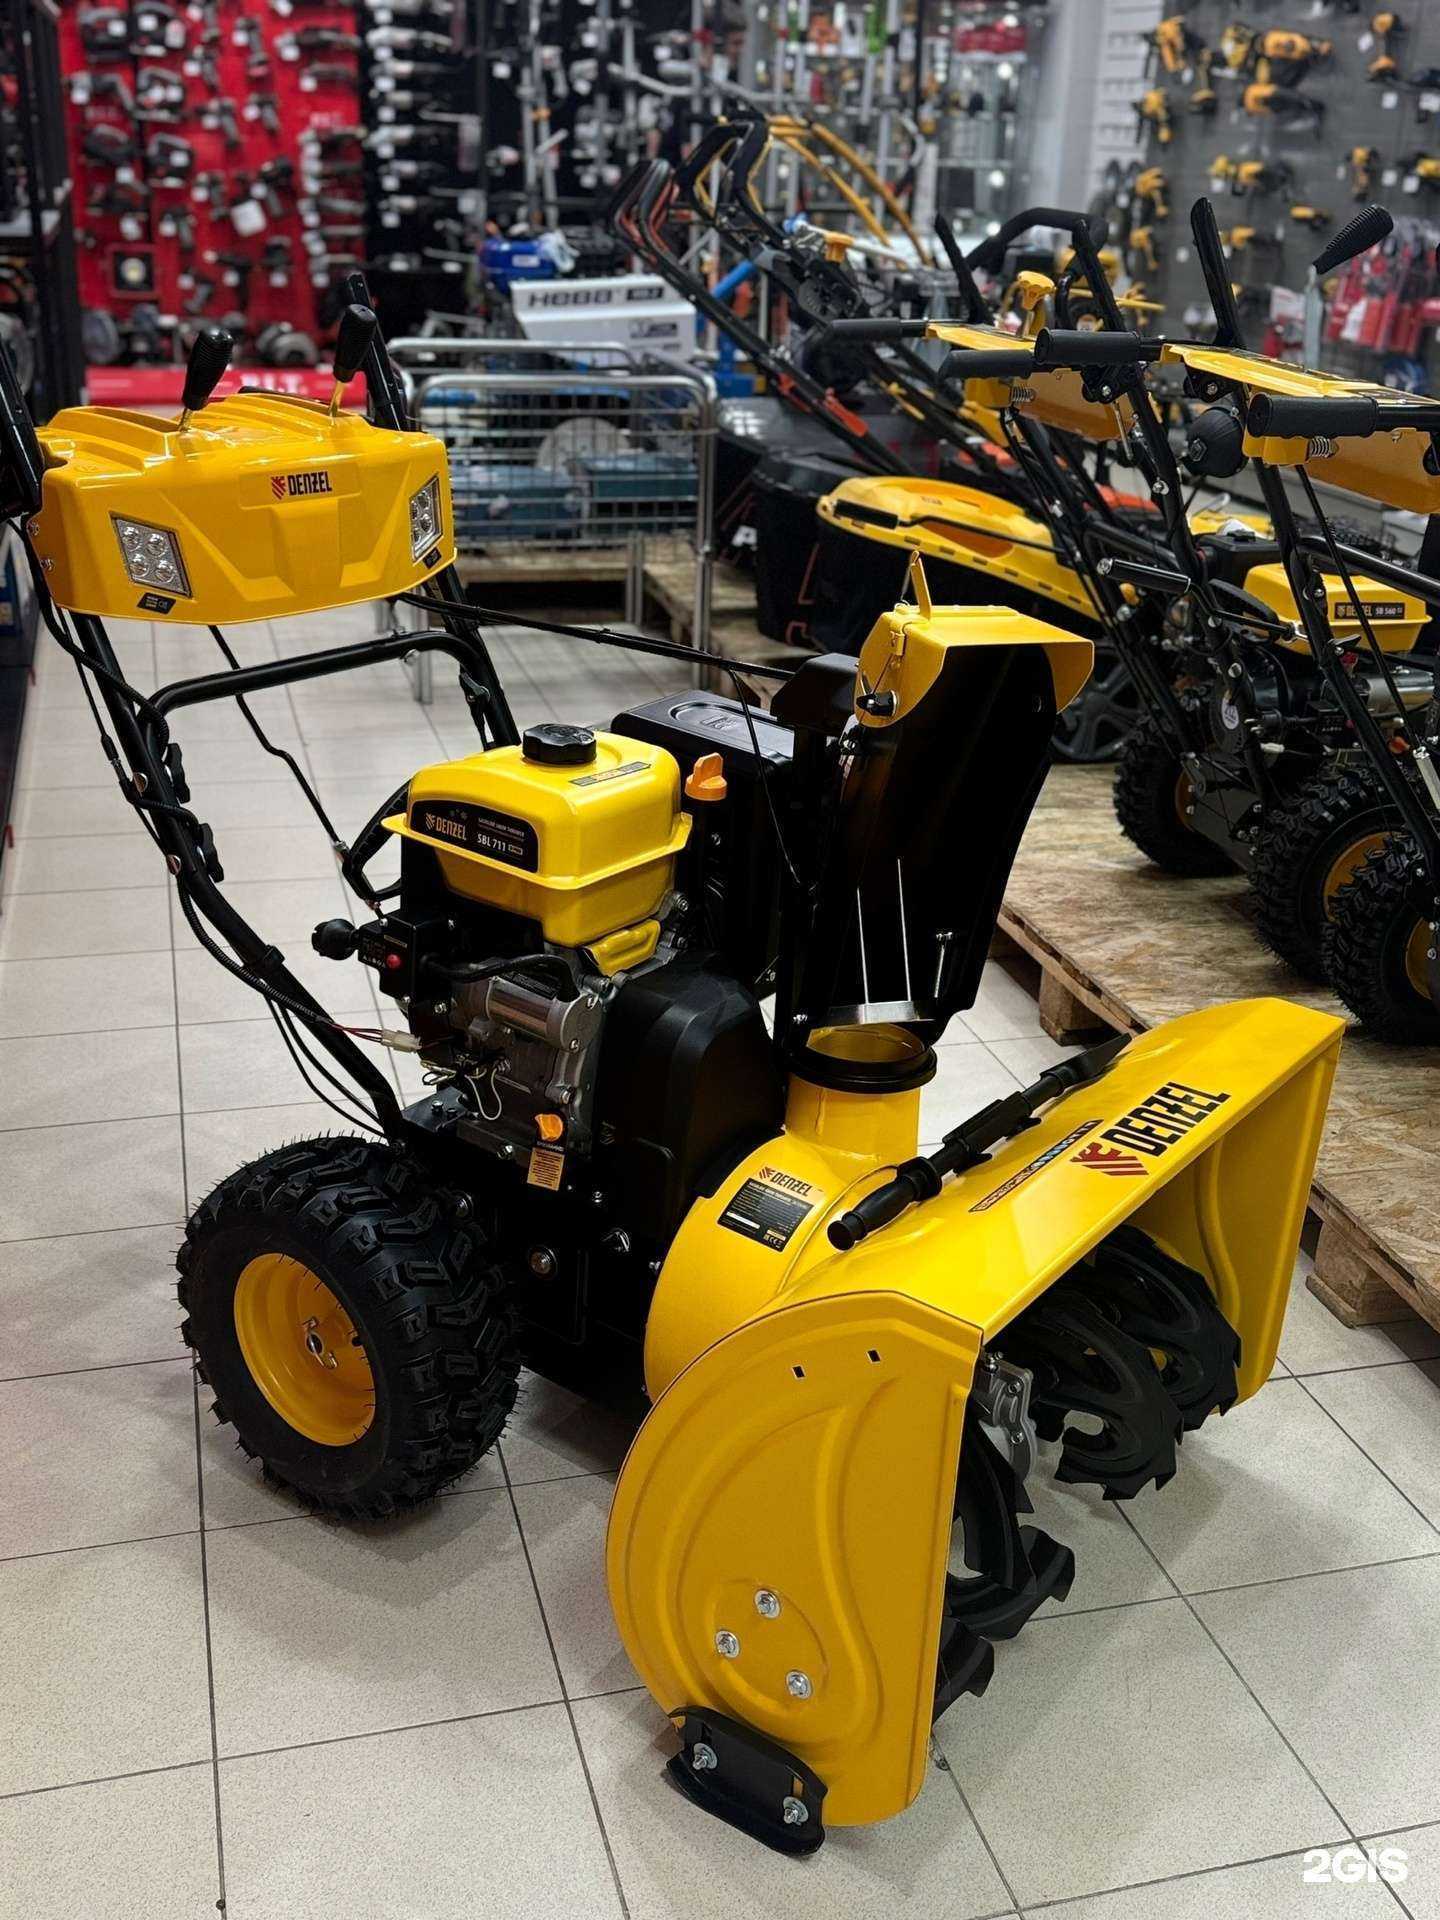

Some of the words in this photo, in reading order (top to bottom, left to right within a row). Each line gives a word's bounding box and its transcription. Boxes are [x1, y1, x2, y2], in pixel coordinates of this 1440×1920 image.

[287, 471, 333, 496] DENZEL
[435, 817, 467, 840] DENZEL
[478, 833, 491, 847] SBL
[493, 839, 506, 852] 711
[1100, 1081, 1232, 1157] DENZEL
[770, 1172, 813, 1197] DENZEL
